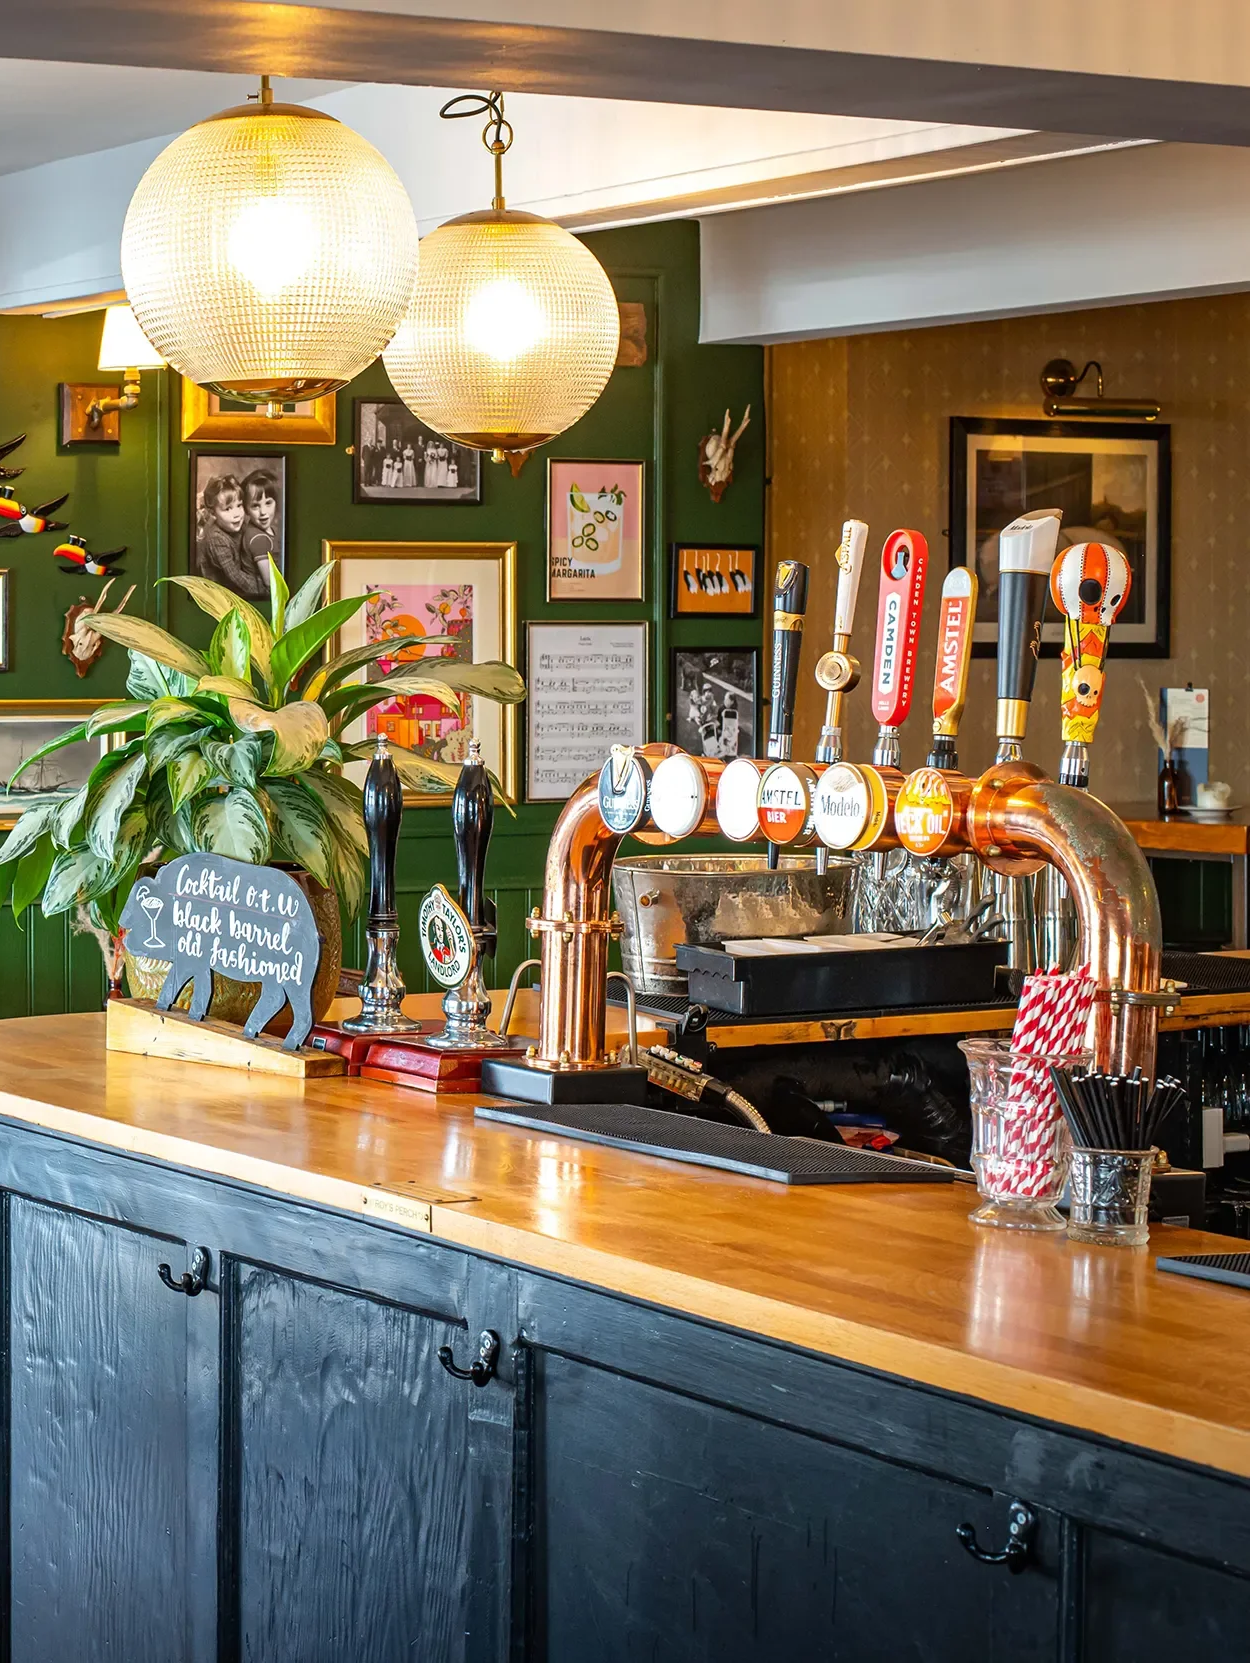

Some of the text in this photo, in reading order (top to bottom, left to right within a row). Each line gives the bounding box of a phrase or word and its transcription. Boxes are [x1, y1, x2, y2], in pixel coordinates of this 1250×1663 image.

[881, 600, 897, 685] CAMDEN
[901, 557, 924, 707] CAMDEN TOWN BREWERY
[940, 600, 963, 696] AMSTEL
[771, 642, 783, 699] GUINNESS
[761, 790, 801, 806] AMSTEL
[766, 810, 788, 824] BIER
[821, 795, 860, 817] Modelo
[176, 864, 240, 905] Cocktail
[172, 900, 293, 955] black barrel
[421, 901, 467, 953] TIMOTHY TAYLOR'S
[177, 931, 303, 985] old fashioned
[428, 952, 461, 978] LANDLORD
